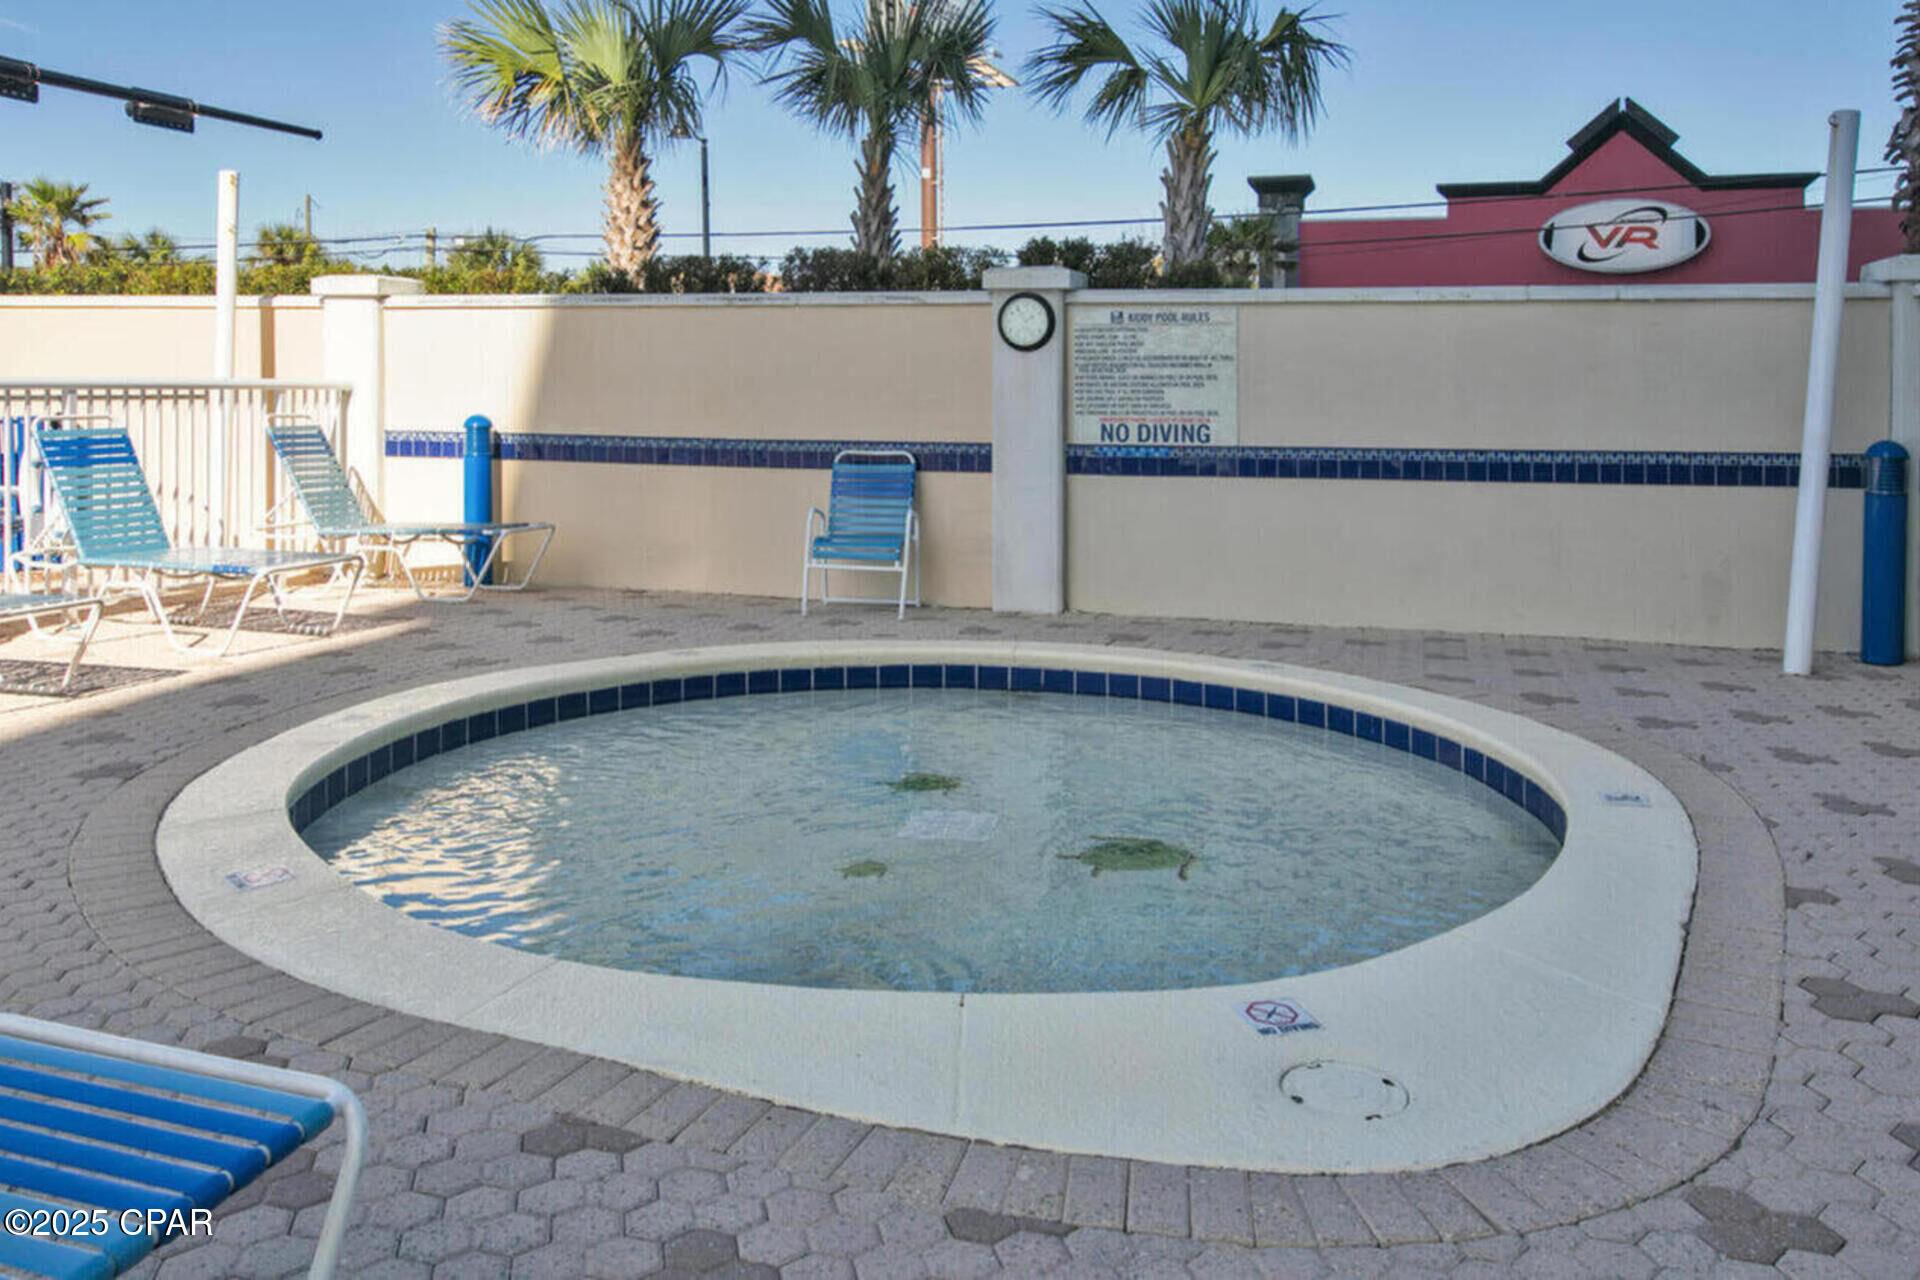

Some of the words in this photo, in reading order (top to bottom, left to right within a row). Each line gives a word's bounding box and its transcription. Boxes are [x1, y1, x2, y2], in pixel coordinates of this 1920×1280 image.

[1585, 225, 1659, 249] VR
[1155, 312, 1178, 323] POOL
[1182, 312, 1210, 322] RULES
[1101, 424, 1129, 443] NO
[1137, 424, 1210, 444] DIVING
